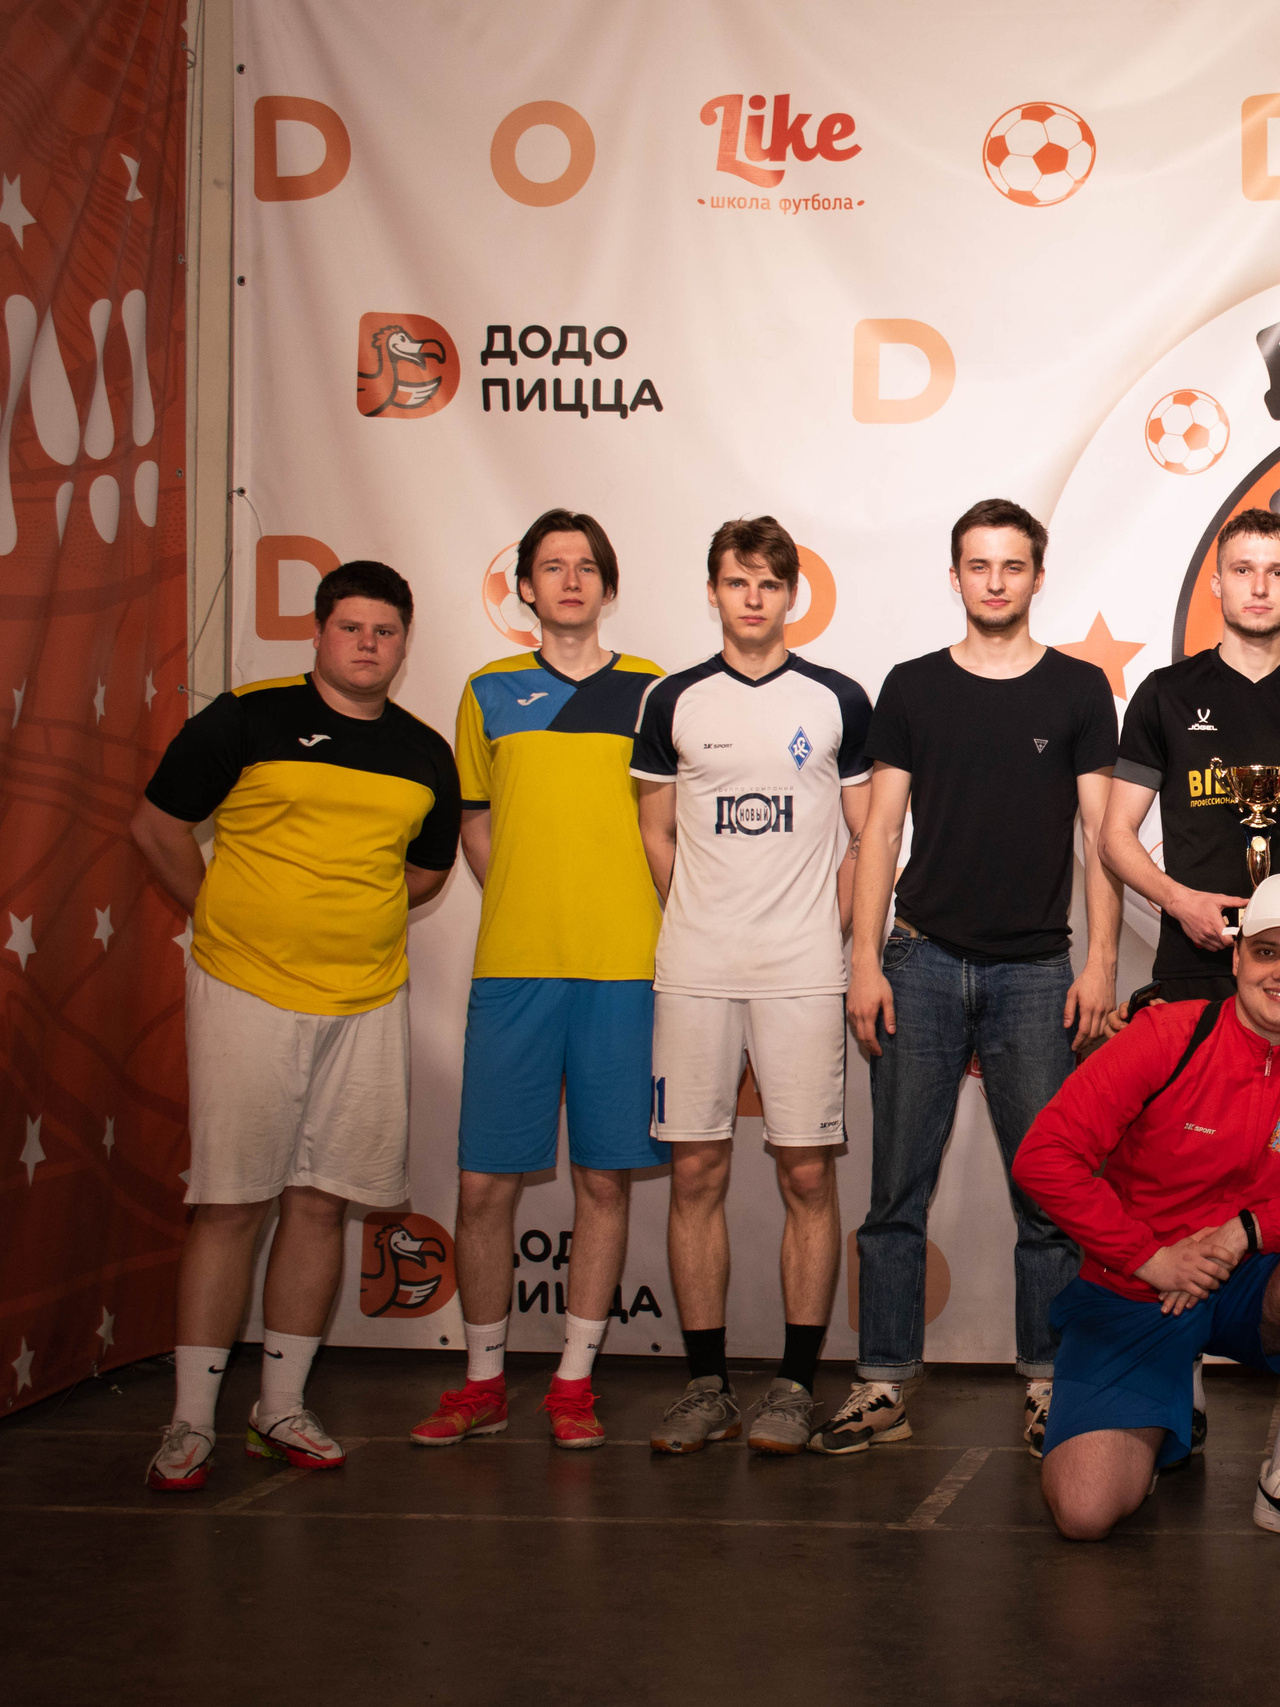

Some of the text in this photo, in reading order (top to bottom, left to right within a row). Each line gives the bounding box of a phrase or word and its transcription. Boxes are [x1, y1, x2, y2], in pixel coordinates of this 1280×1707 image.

[254, 95, 351, 202] D
[700, 93, 862, 188] Like
[710, 193, 853, 215] школа футбола
[480, 325, 628, 366] ДОДО
[852, 318, 956, 424] D
[481, 377, 664, 420] ПИЦЦА
[715, 793, 793, 836] ДОН
[740, 805, 769, 822] НОВЫЙ
